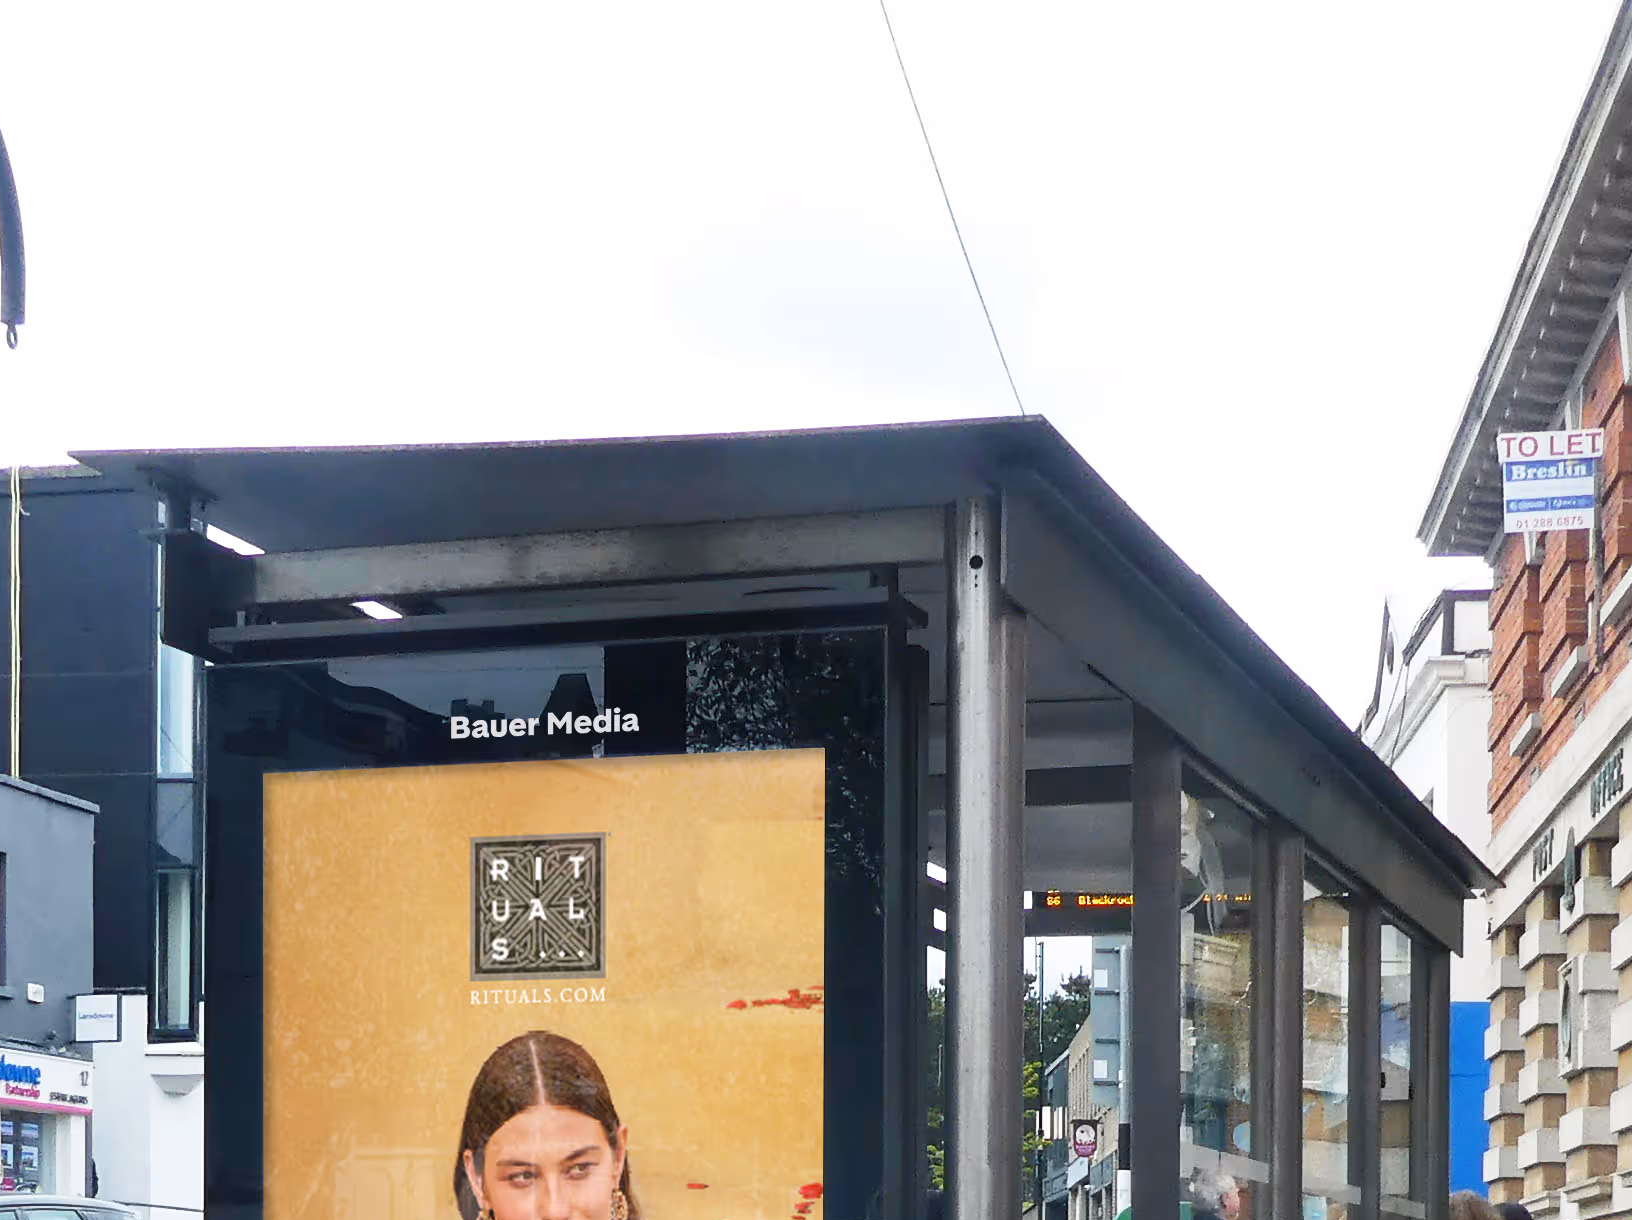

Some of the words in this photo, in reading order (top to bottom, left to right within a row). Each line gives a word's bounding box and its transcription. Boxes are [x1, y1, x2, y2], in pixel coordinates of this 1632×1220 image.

[1501, 436, 1539, 458] TO
[1549, 431, 1602, 456] LET
[1511, 461, 1587, 481] Breslin
[449, 714, 540, 740] Bauer
[546, 706, 640, 736] Media
[469, 986, 607, 1005] RITUALS.COM
